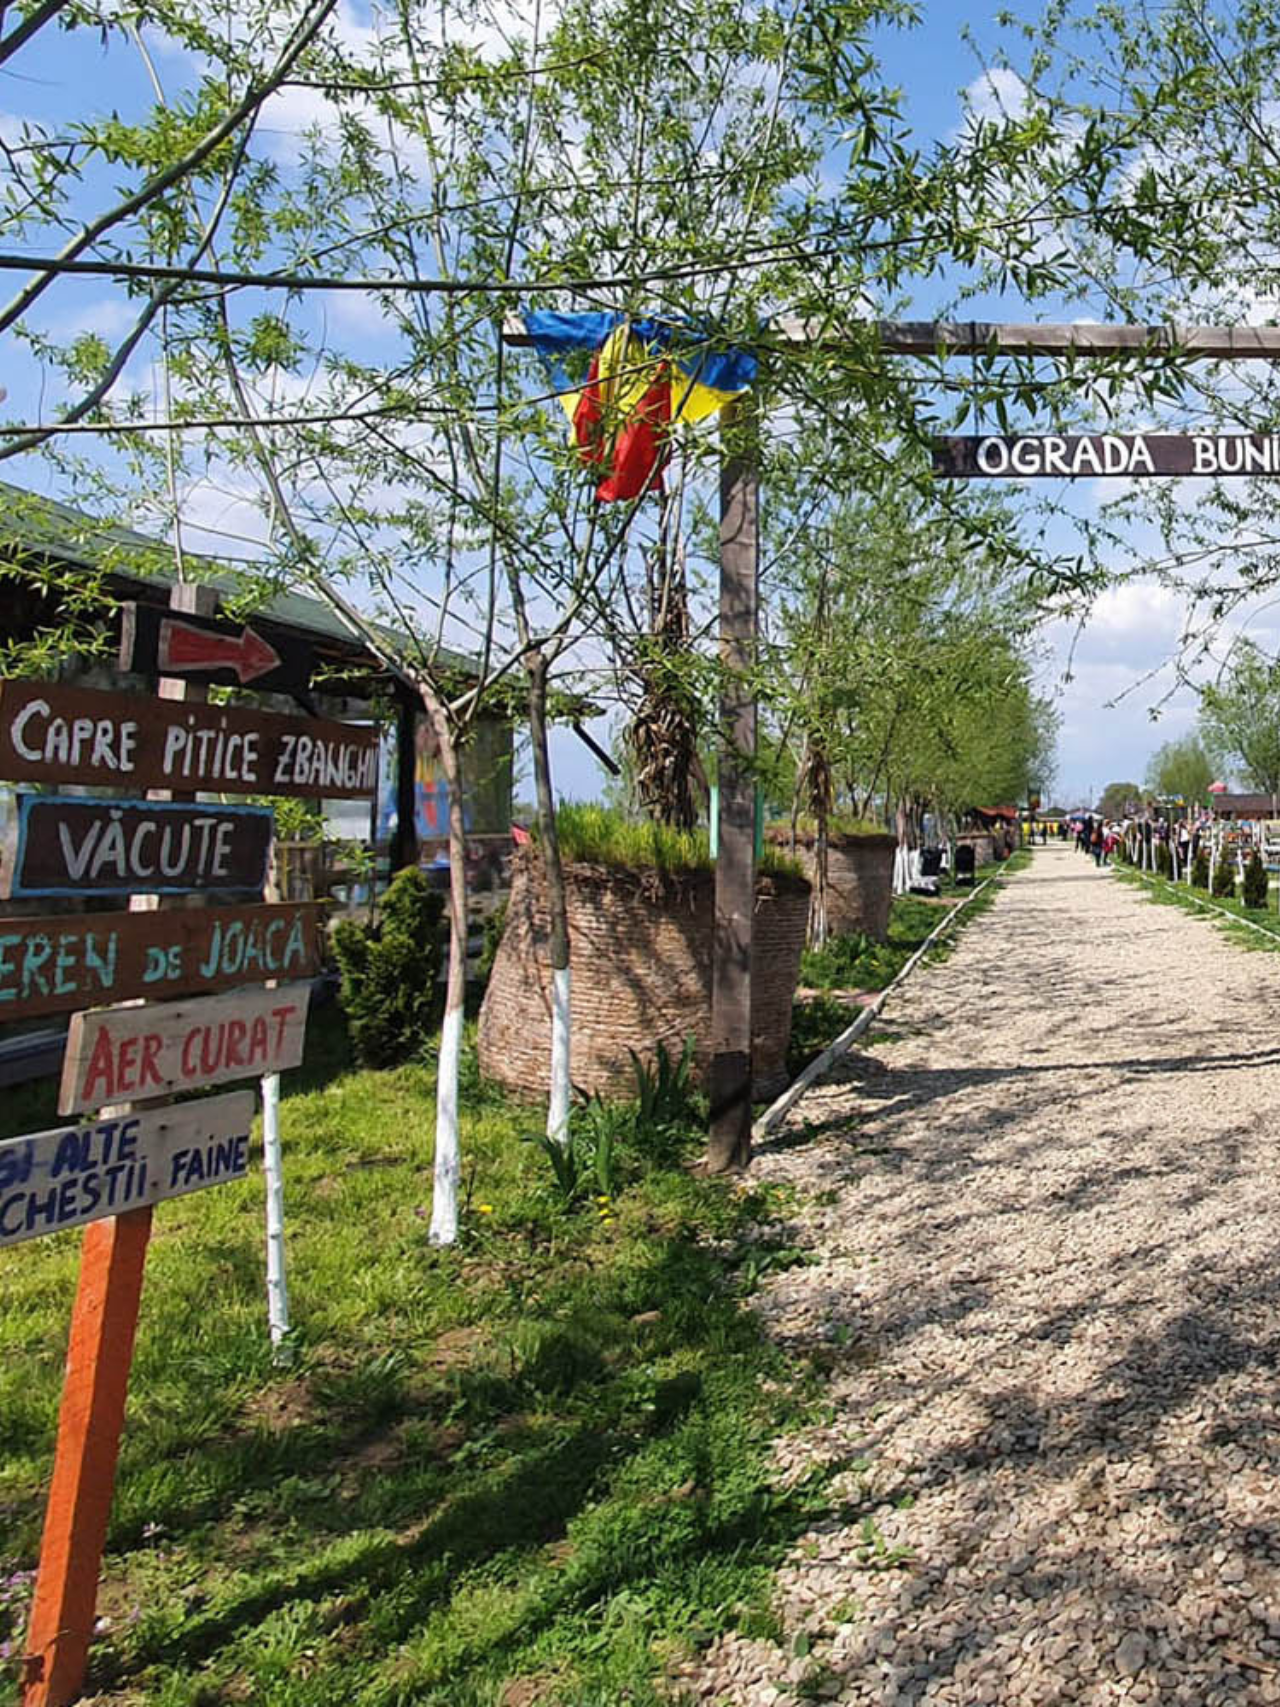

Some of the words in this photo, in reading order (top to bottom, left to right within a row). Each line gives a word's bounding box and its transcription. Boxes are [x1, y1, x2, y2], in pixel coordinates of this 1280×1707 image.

[977, 436, 1155, 475] OGRADA
[11, 699, 138, 773] CAPRE
[163, 714, 260, 781] PITICE
[143, 945, 183, 983] DE
[82, 1025, 163, 1101] AER
[181, 1005, 297, 1078] CURAT
[51, 1119, 140, 1178] ALTE
[0, 1155, 148, 1237] CHESTII
[170, 1134, 249, 1190] FAINE
